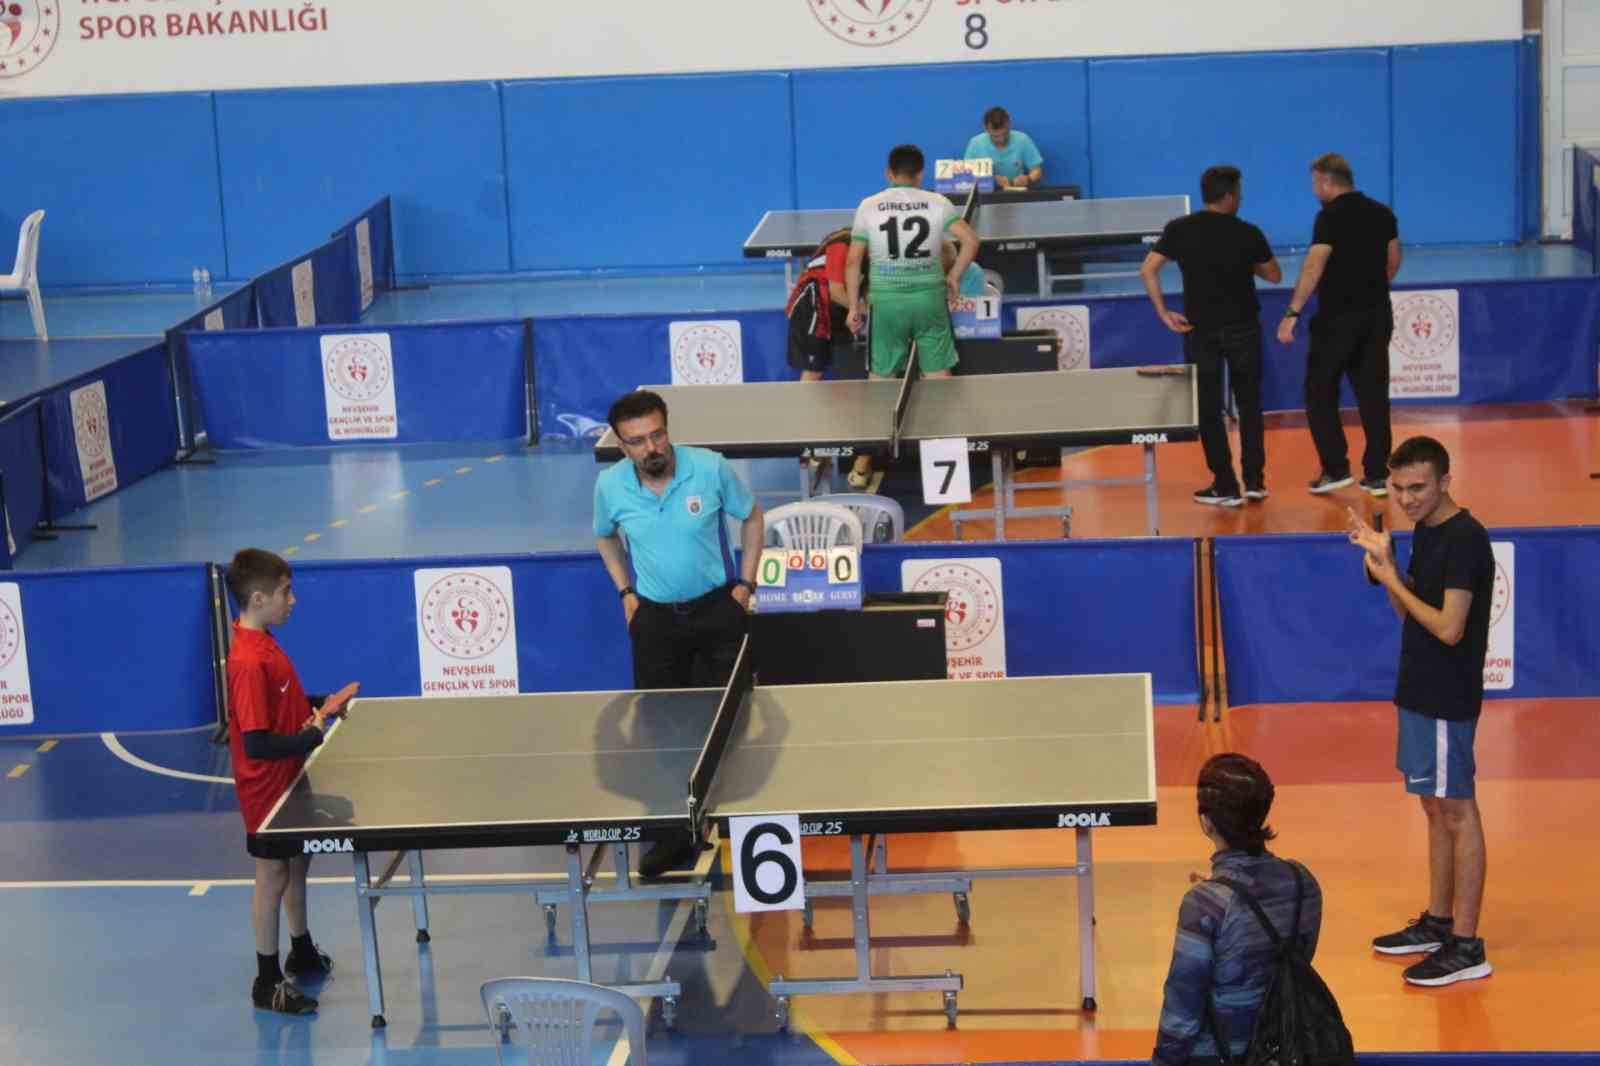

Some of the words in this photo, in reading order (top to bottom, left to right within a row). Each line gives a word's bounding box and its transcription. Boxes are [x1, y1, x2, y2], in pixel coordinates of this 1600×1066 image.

[79, 15, 157, 40] SPOR
[166, 2, 328, 36] BAKANLIĞI
[964, 13, 988, 50] 8
[879, 214, 931, 260] 12
[983, 300, 991, 317] 1
[1132, 433, 1168, 443] JOOLA
[933, 460, 957, 494] 7
[763, 558, 781, 584] 0
[789, 555, 803, 568] 0
[811, 555, 825, 568] 0
[834, 555, 851, 581] 0
[442, 664, 496, 677] NEVŞEHİR
[424, 681, 468, 692] GENÇLİK
[471, 680, 485, 689] VE
[488, 679, 516, 689] SPOR
[2, 692, 29, 704] SPOR
[1057, 812, 1111, 827] JOOLA
[624, 826, 641, 840] 25
[825, 821, 842, 834] 25
[303, 838, 354, 853] JOOLA
[741, 822, 797, 904] 6
